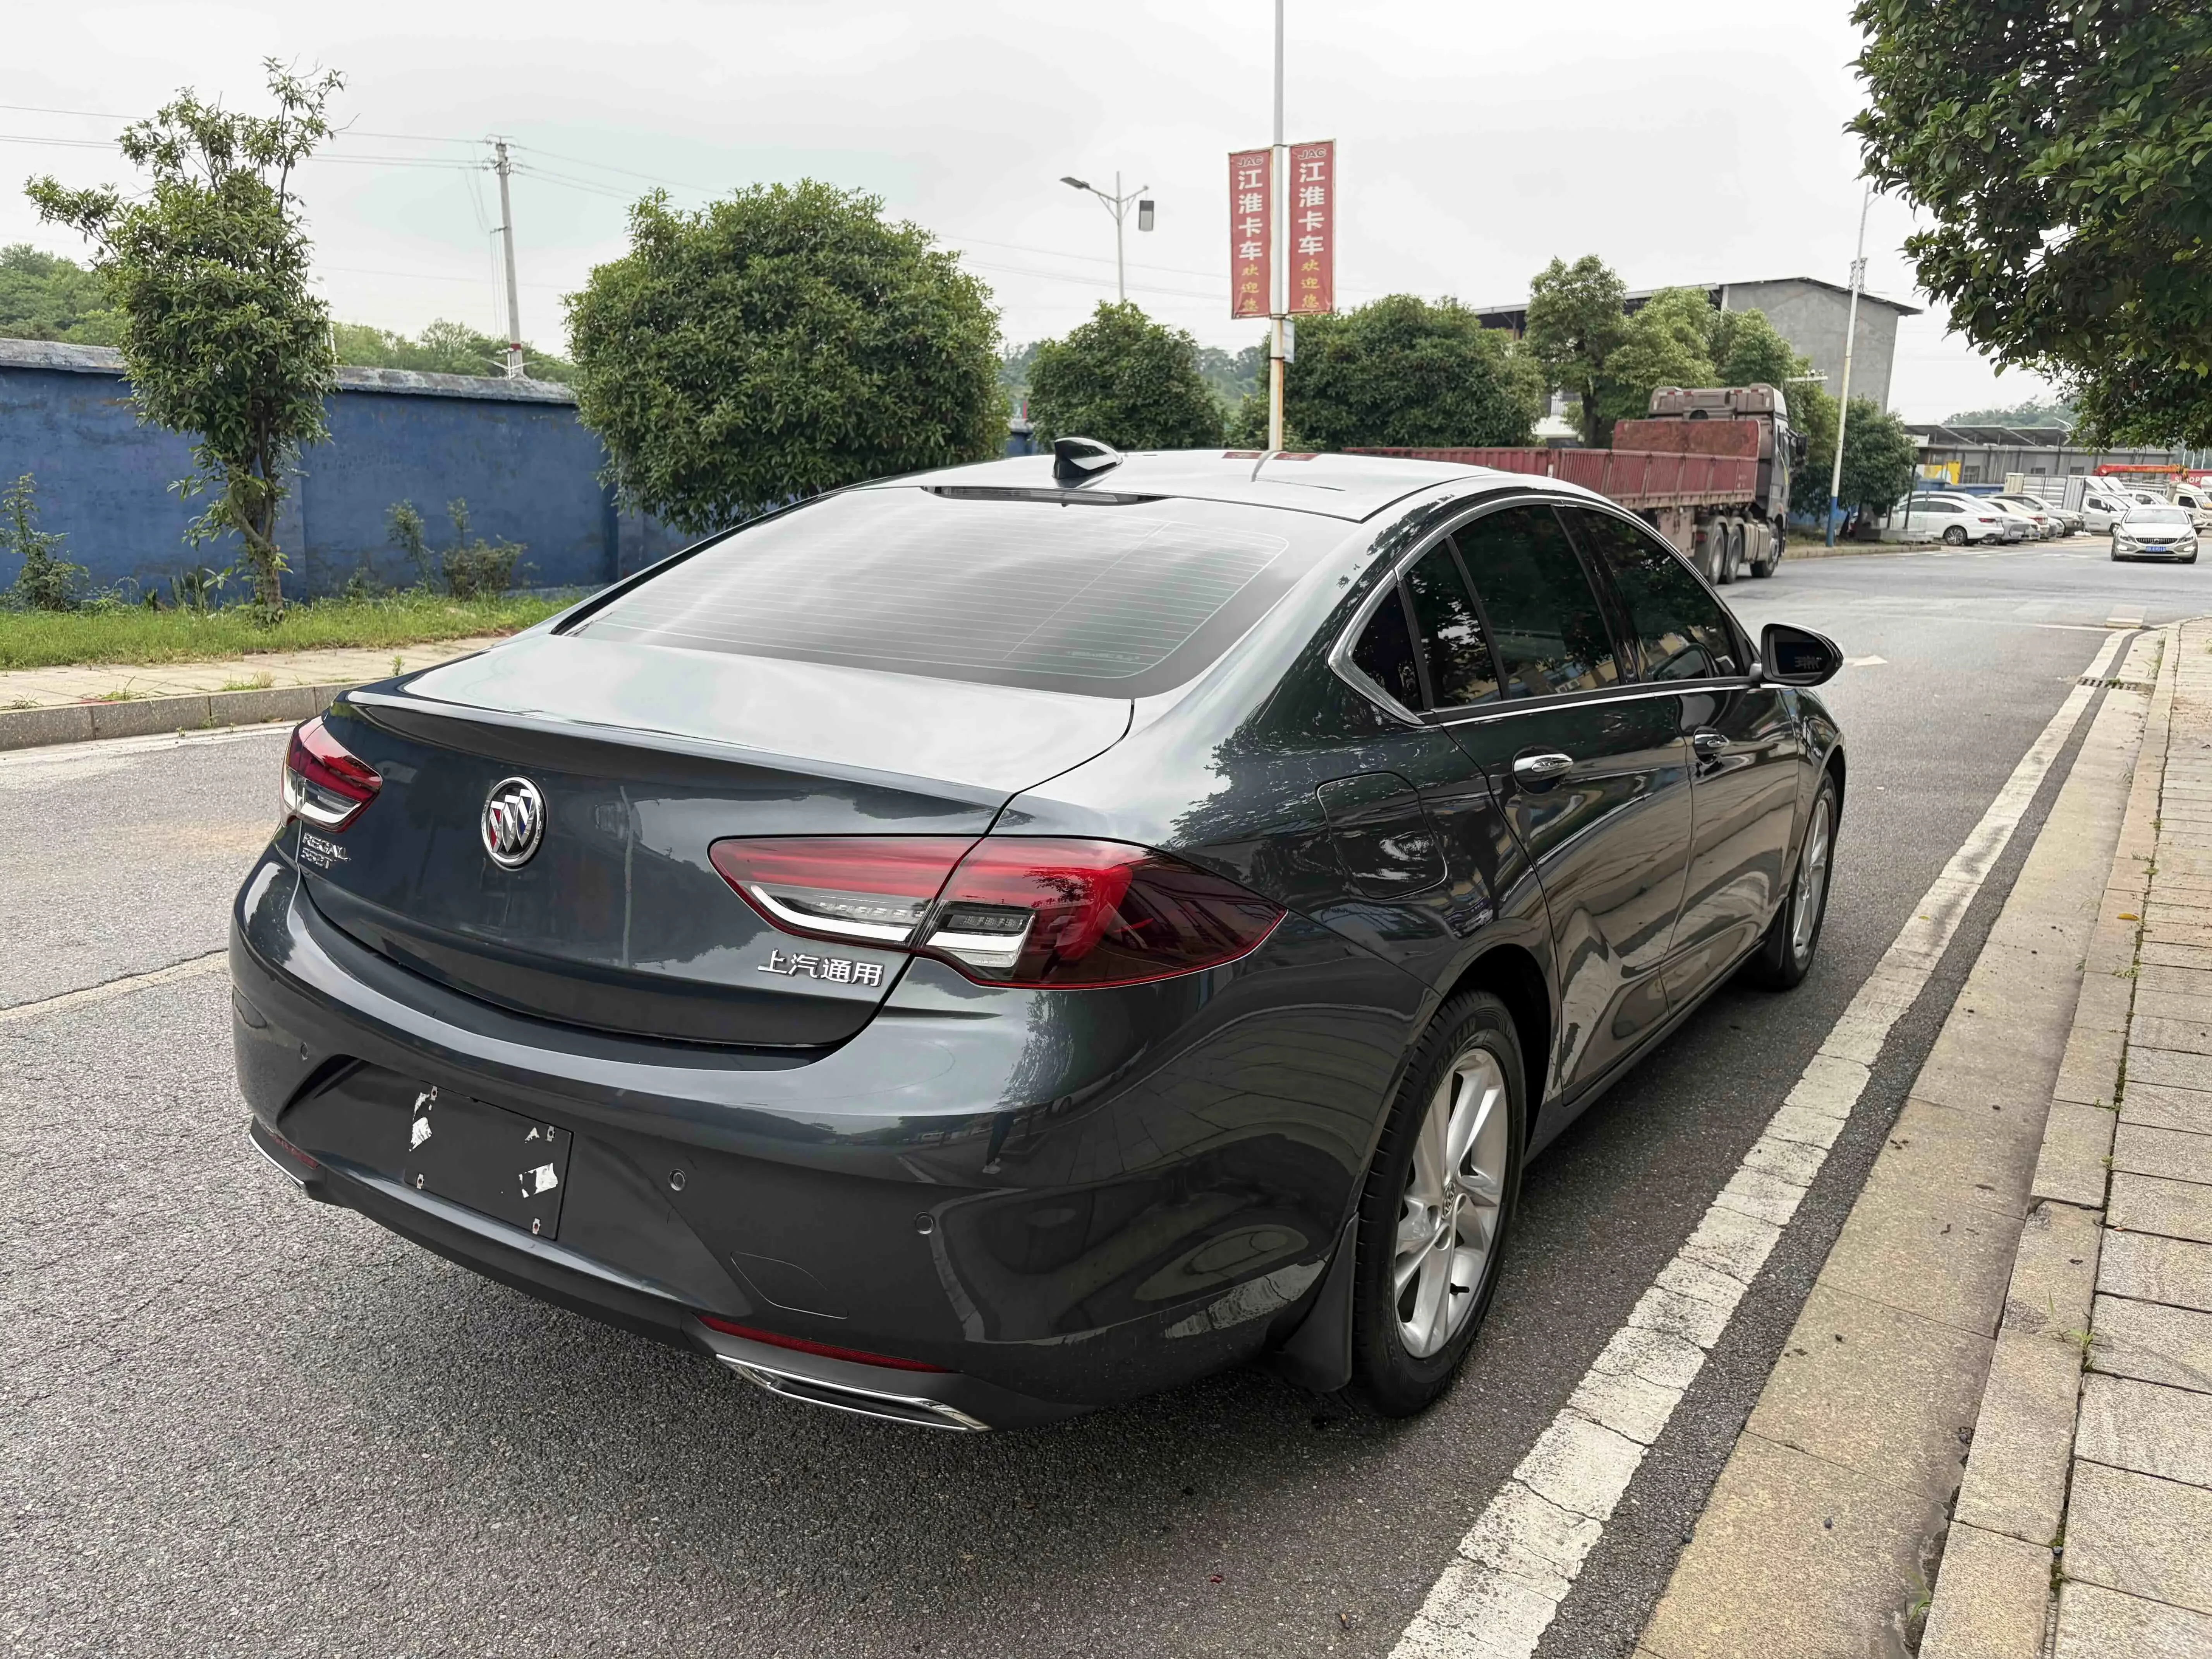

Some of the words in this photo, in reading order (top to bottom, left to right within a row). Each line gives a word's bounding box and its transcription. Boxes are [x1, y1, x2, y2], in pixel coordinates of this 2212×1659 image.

[1238, 156, 1264, 168] JAC
[1298, 148, 1326, 160] JAC
[1238, 169, 1263, 260] 江淮卡车
[1298, 161, 1326, 256] 江淮卡车
[302, 833, 349, 860] REGAL
[757, 948, 884, 987] 上汽通用
